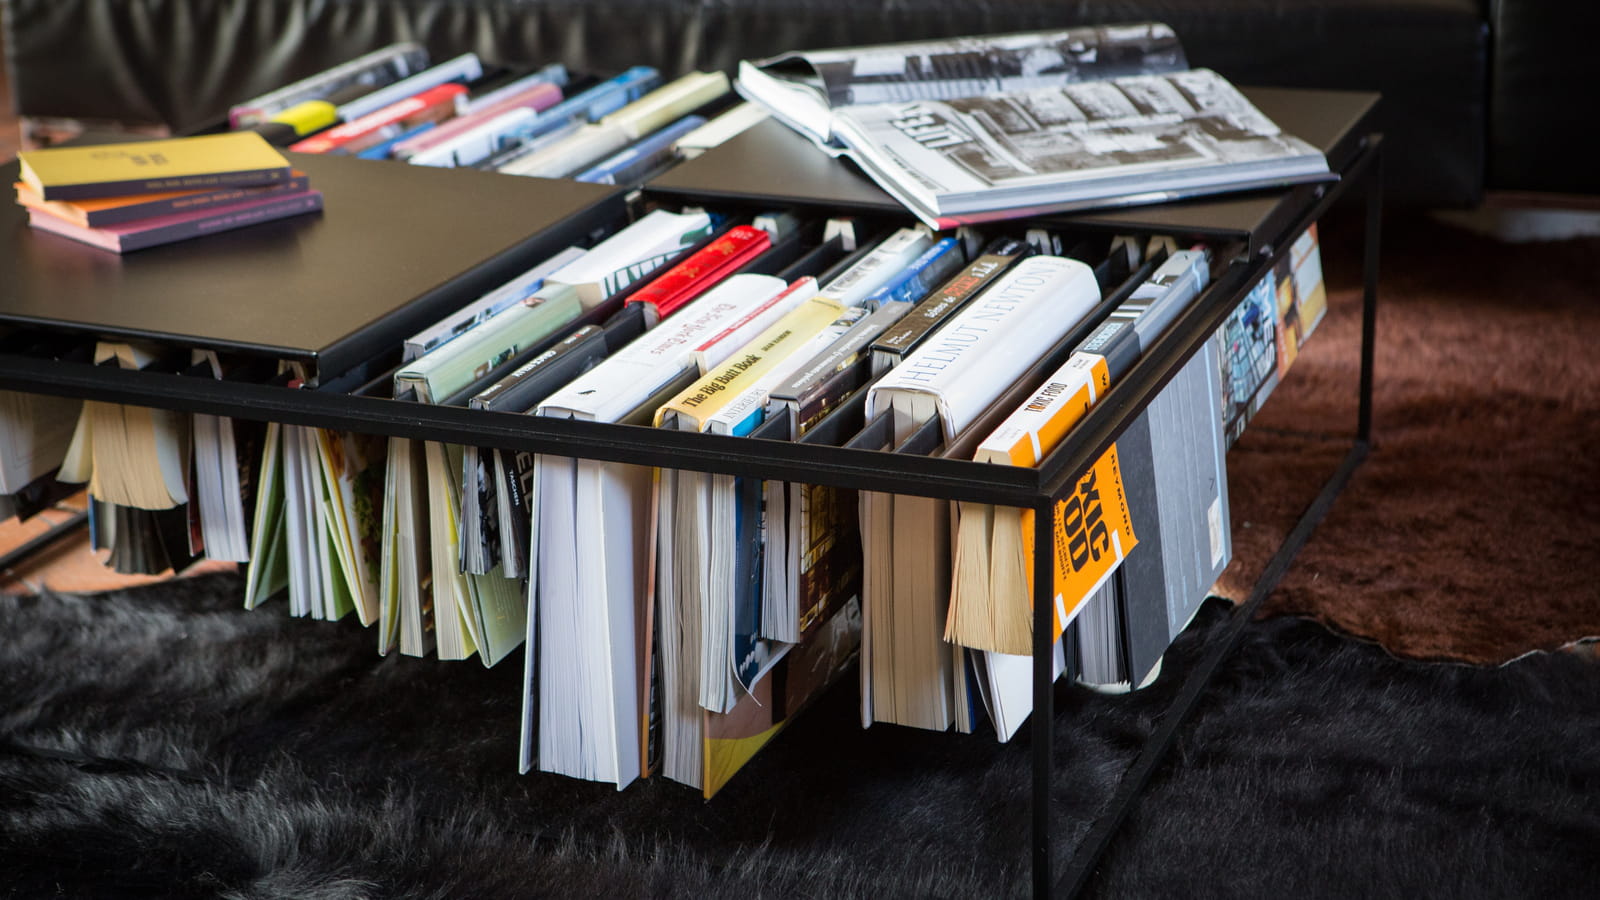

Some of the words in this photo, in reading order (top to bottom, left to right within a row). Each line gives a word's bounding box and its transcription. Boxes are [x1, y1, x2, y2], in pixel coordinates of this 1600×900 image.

[900, 324, 988, 382] HELMUT
[972, 266, 1058, 322] NEWTON
[682, 391, 708, 407] The
[701, 380, 726, 396] Big
[714, 367, 742, 385] Butt
[734, 353, 762, 372] Book
[1024, 397, 1054, 413] TOXIC
[1041, 382, 1068, 397] FOOD
[509, 469, 520, 506] TASCHEN
[1080, 468, 1109, 563] XIC
[1110, 453, 1131, 537] REYMOND
[1063, 495, 1090, 573] OD
